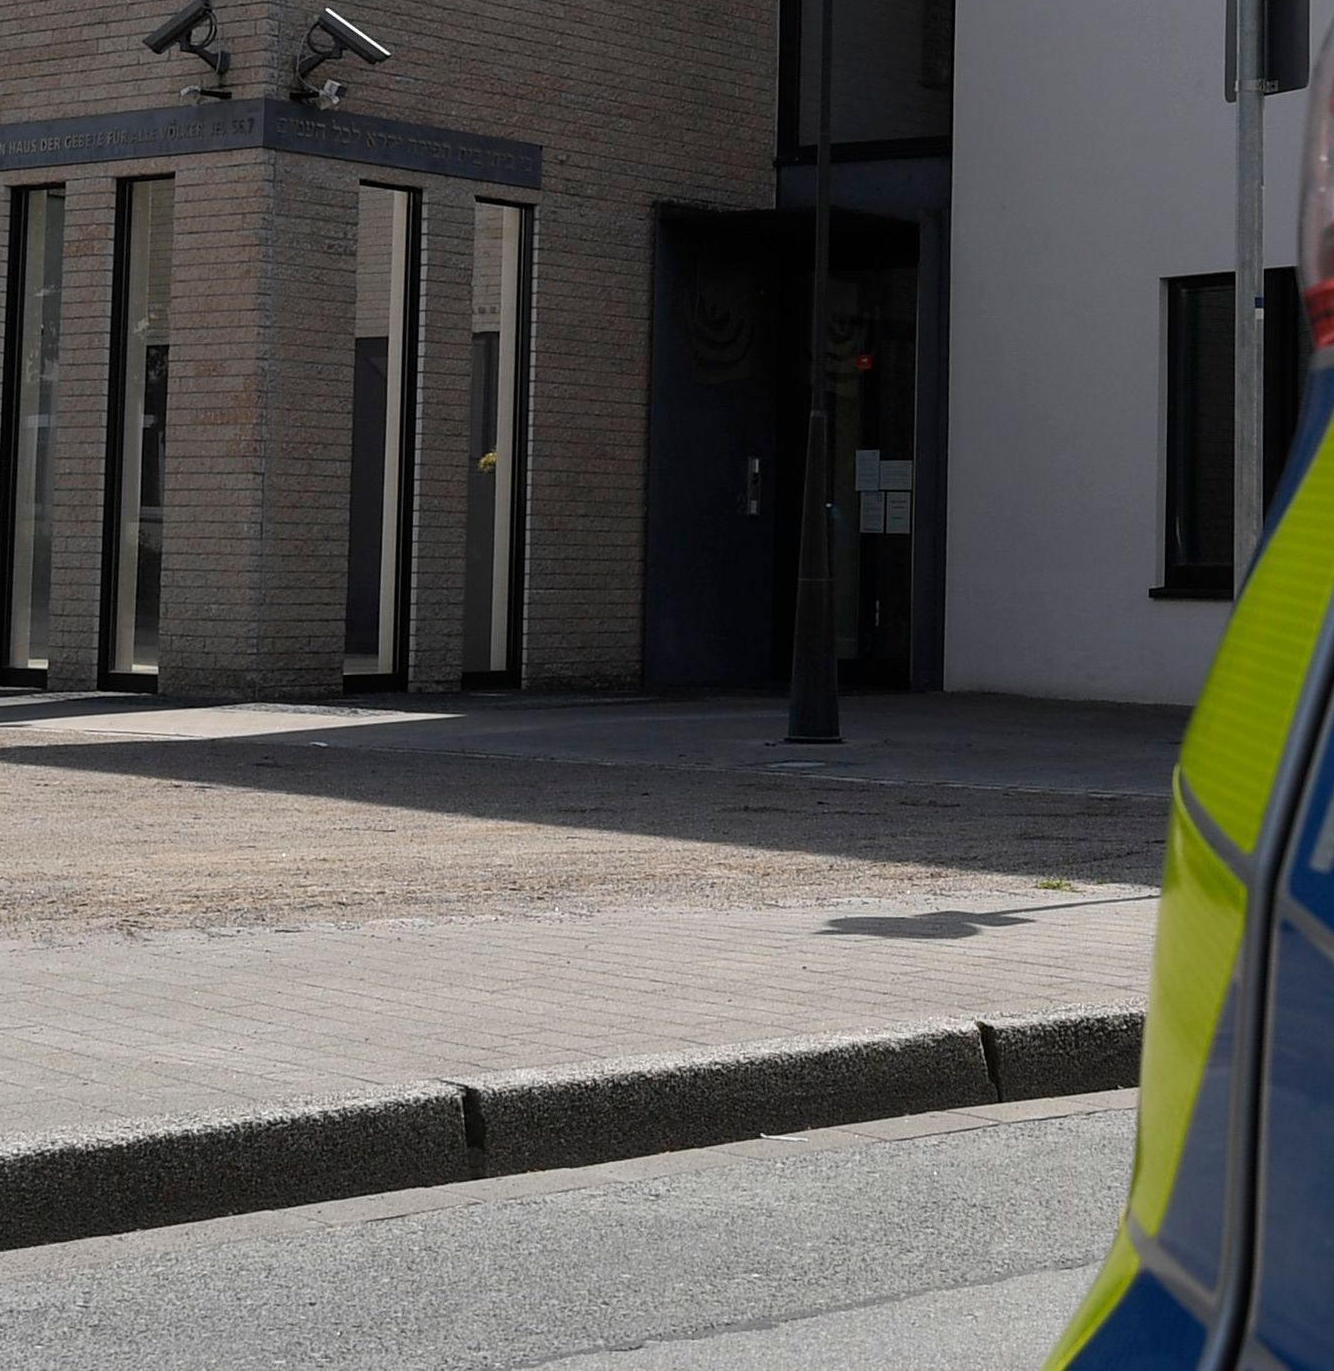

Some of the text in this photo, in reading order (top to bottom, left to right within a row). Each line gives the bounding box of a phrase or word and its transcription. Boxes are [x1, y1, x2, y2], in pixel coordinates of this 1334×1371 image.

[8, 139, 37, 154] HAUS
[40, 136, 60, 151] DER
[64, 131, 104, 149] GEBETE
[107, 125, 127, 145] FÜR
[162, 119, 203, 141] VÖLKER
